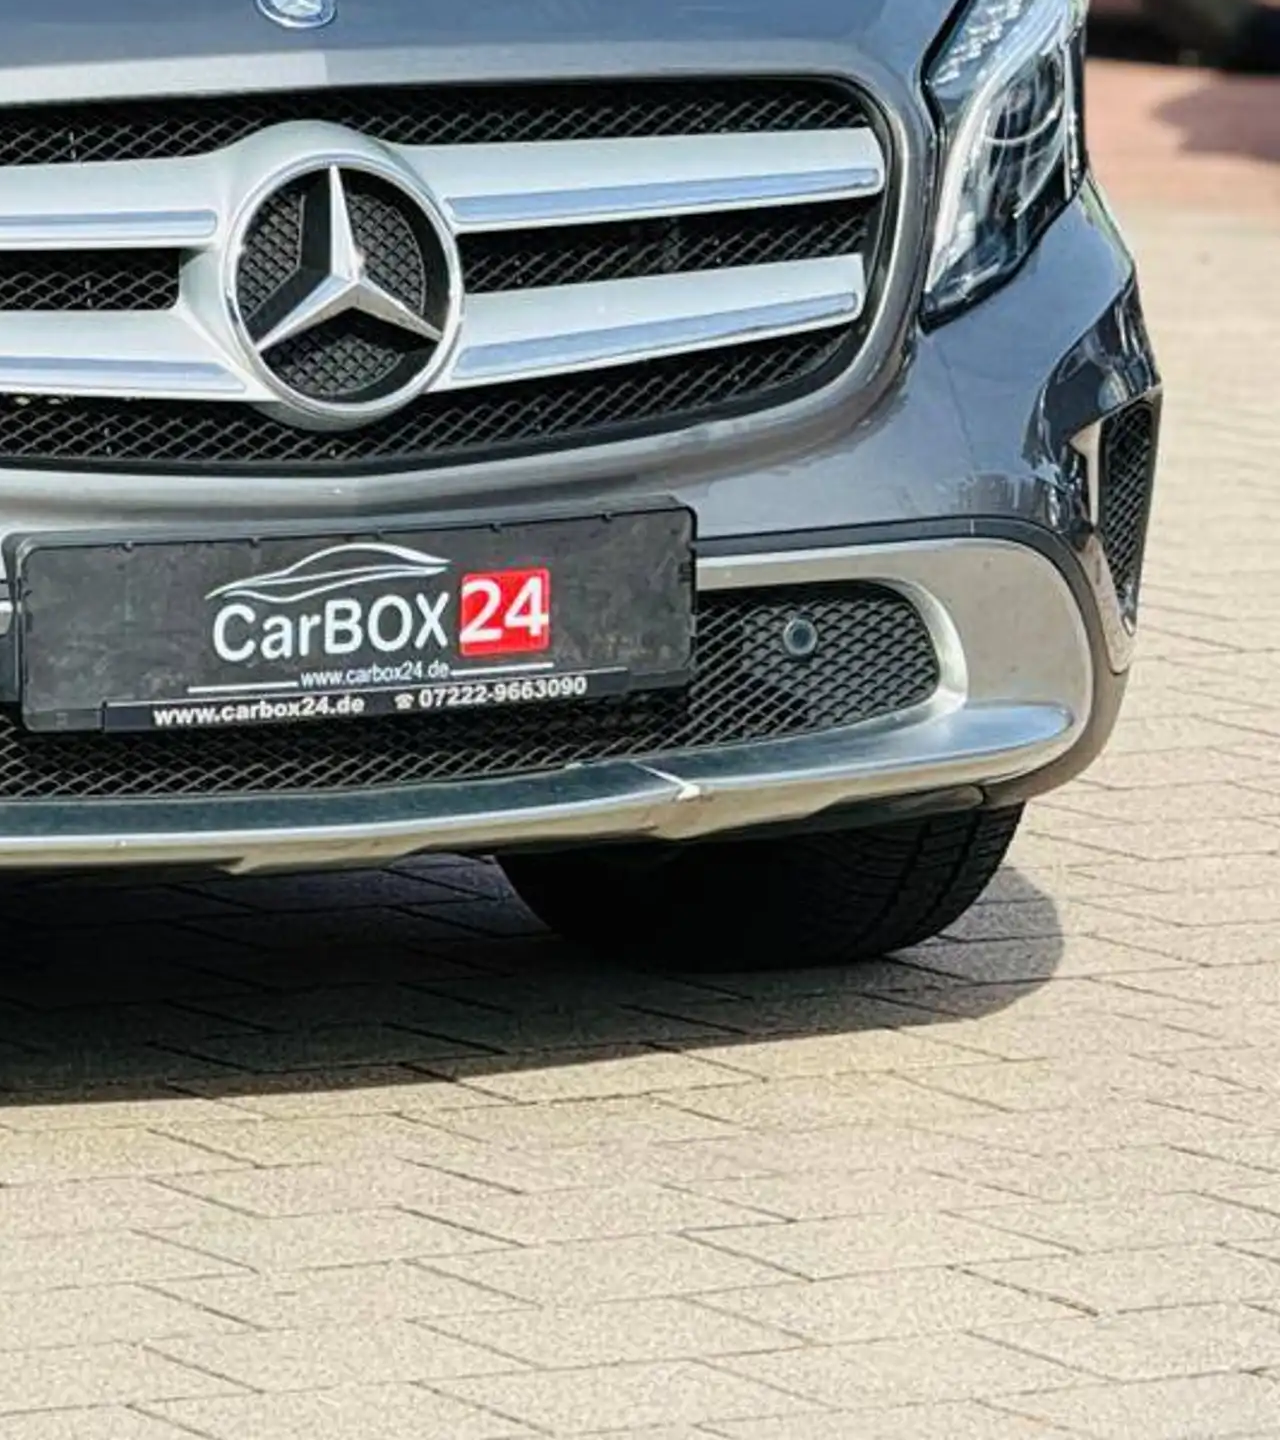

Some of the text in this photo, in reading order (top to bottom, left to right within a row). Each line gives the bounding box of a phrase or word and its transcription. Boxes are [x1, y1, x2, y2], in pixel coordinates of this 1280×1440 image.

[300, 660, 450, 688] www.carbox24.de
[153, 676, 589, 727] www.carbox24.de 07222-9663090
